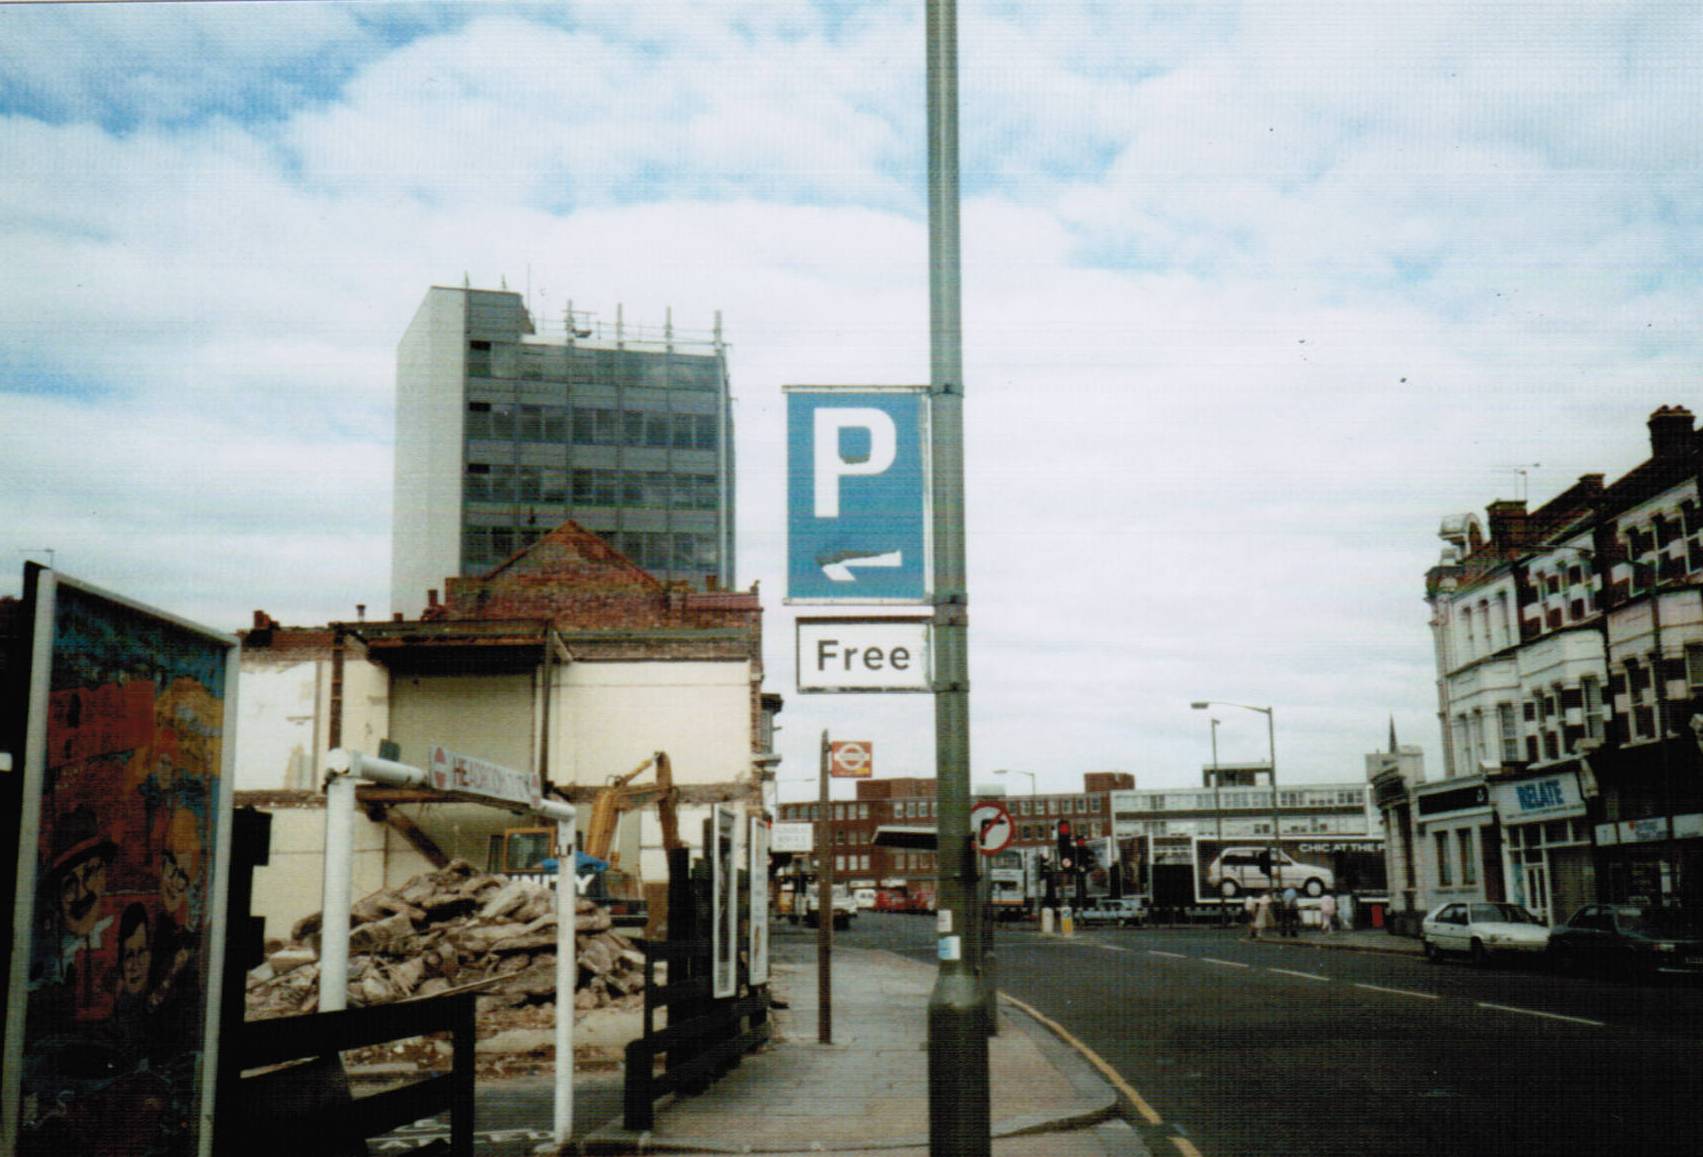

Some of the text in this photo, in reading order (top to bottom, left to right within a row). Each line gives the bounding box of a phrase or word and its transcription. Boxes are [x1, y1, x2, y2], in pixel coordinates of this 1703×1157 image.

[814, 408, 897, 517] P
[817, 640, 910, 671] Free
[1516, 780, 1564, 811] RELATE
